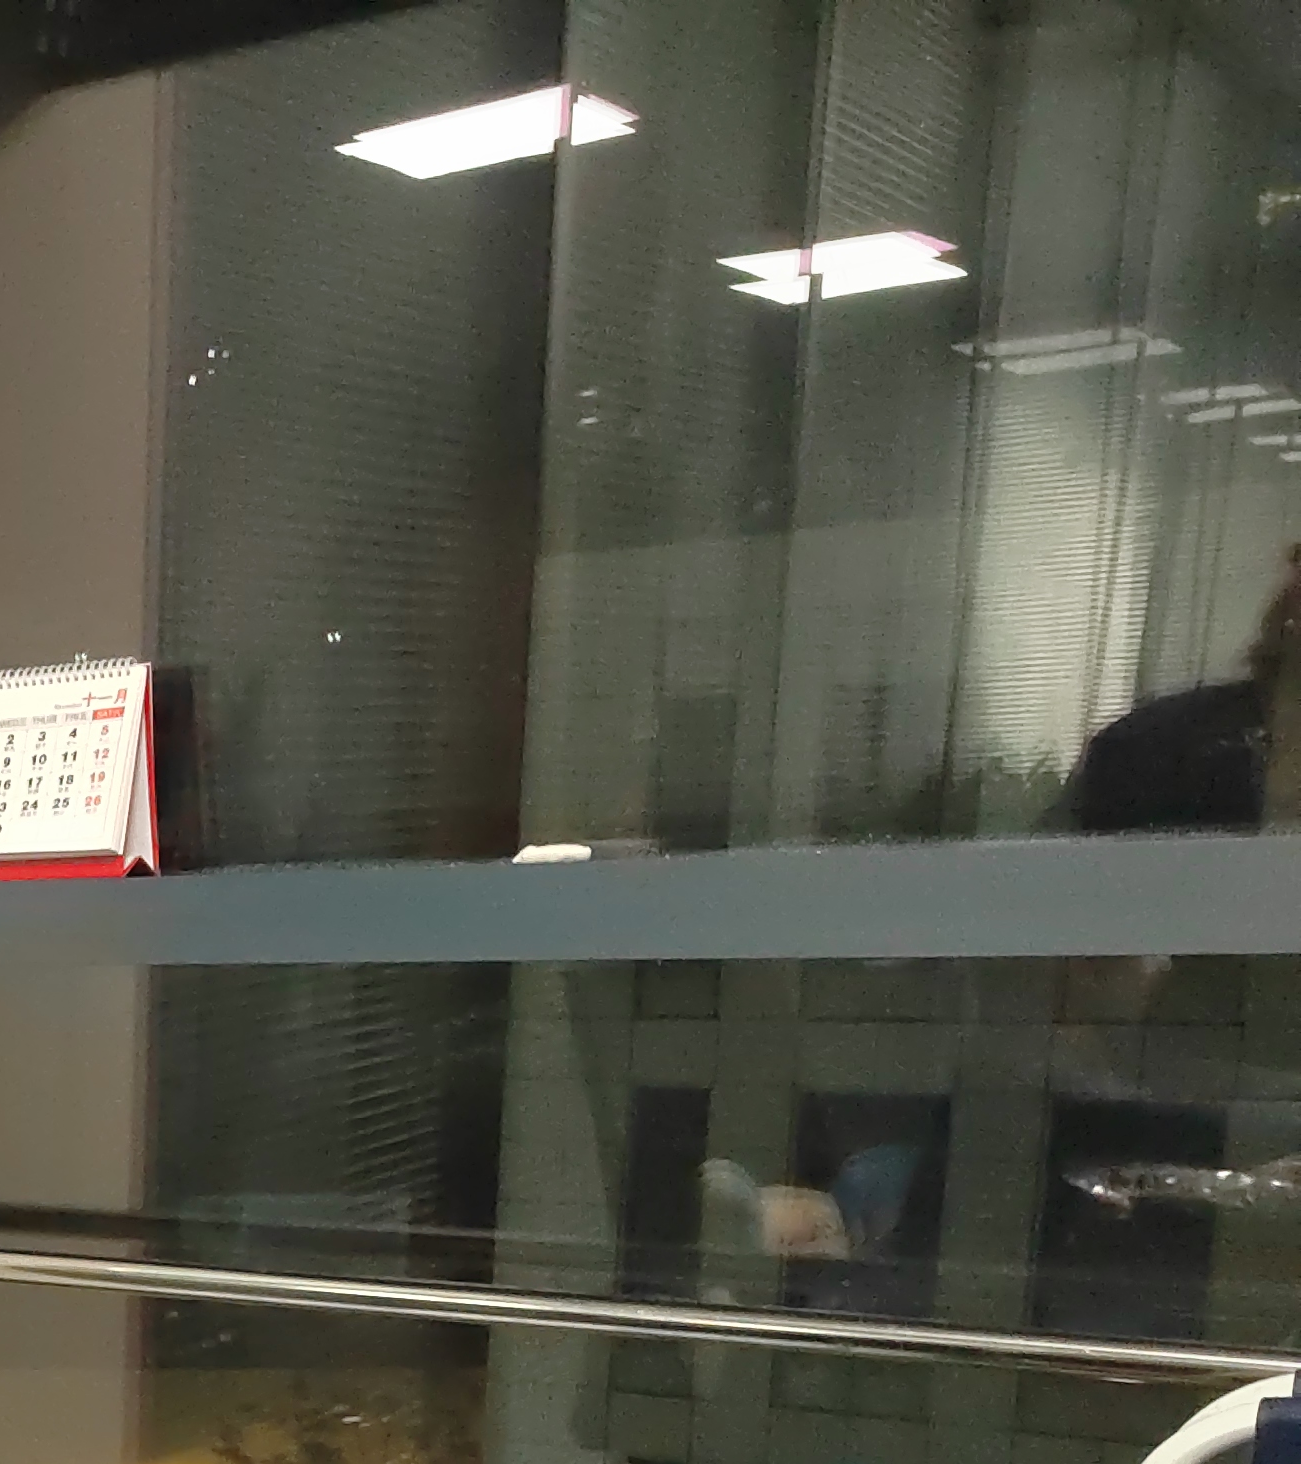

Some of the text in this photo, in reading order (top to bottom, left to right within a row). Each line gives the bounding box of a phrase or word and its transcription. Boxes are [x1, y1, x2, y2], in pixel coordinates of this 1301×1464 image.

[82, 688, 127, 707] 十一月
[6, 734, 14, 745] 2
[38, 731, 46, 741] 3
[69, 728, 77, 738] 4
[101, 725, 109, 735] 5
[3, 757, 11, 768] 9
[32, 754, 47, 765] 10
[62, 751, 77, 762] 11
[94, 748, 110, 759] 12
[27, 776, 43, 788] 17
[58, 775, 74, 785] 18
[90, 771, 105, 783] 19
[21, 800, 38, 811] 24
[52, 797, 70, 809] 25
[85, 795, 102, 807] 26
